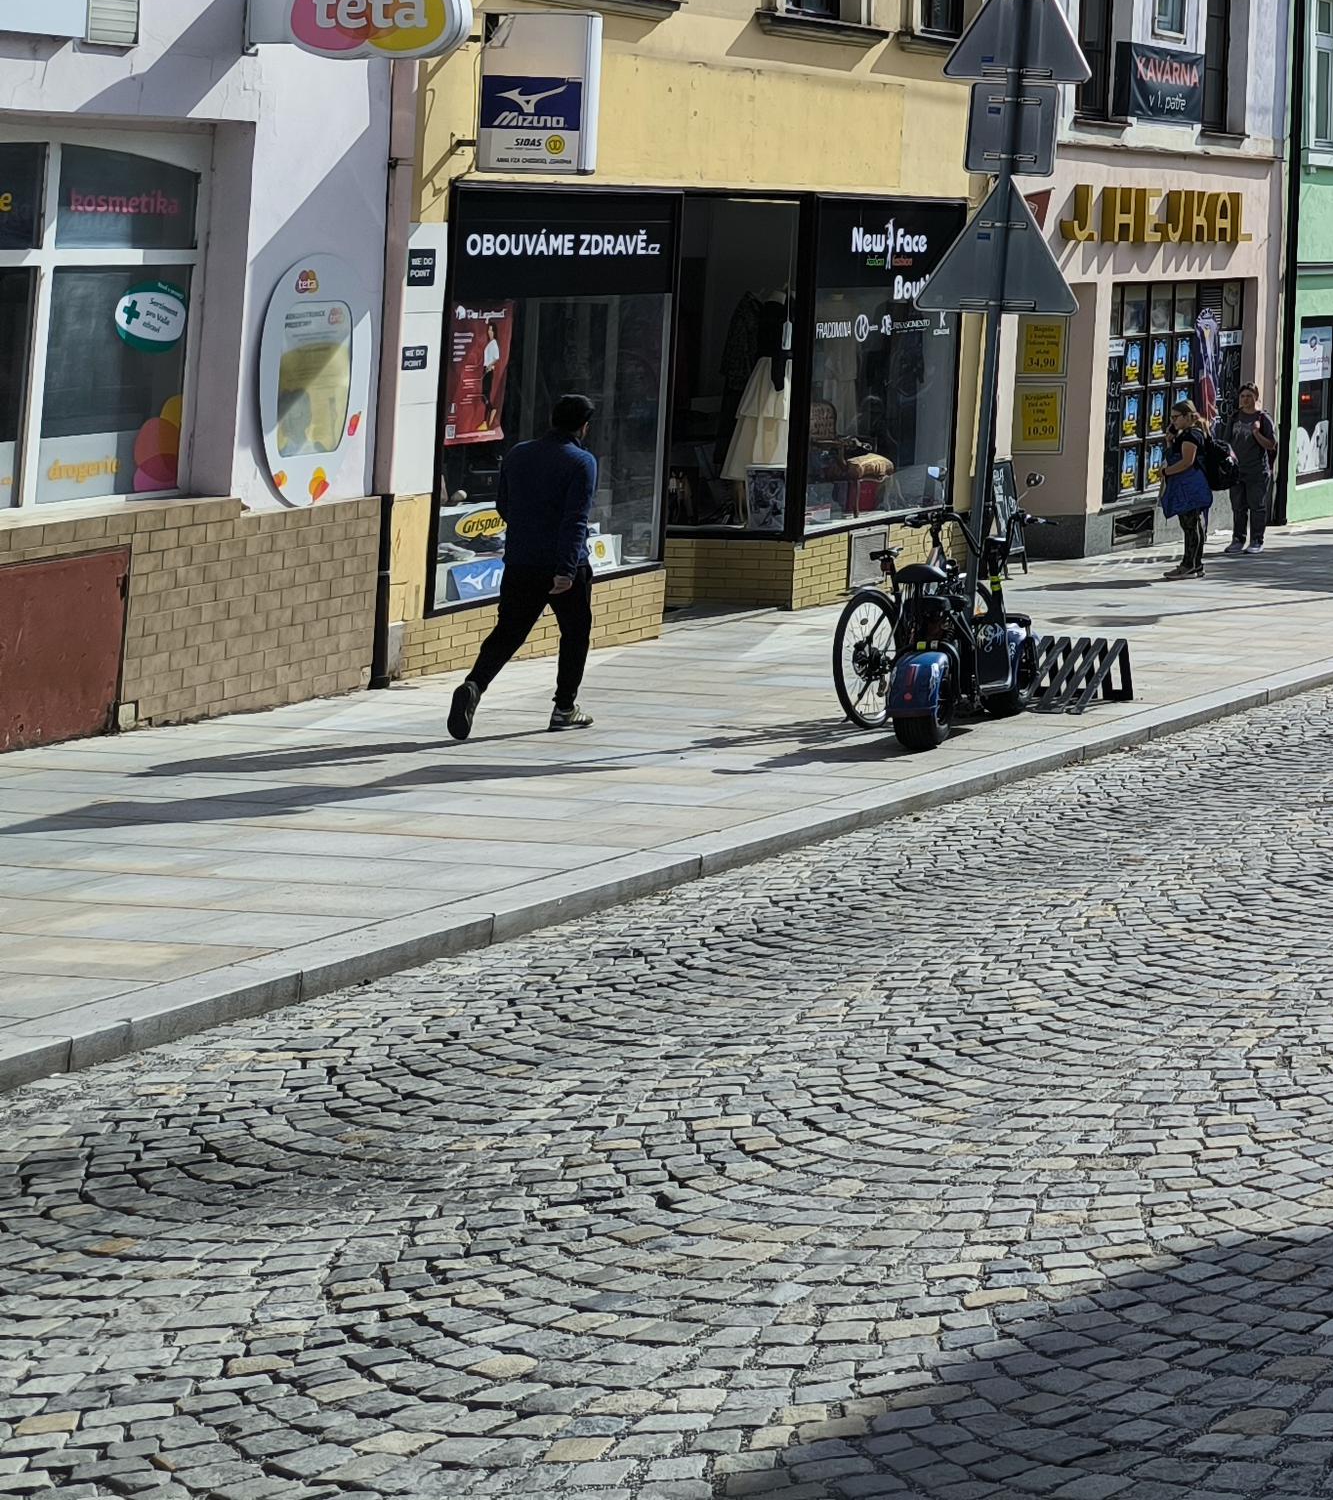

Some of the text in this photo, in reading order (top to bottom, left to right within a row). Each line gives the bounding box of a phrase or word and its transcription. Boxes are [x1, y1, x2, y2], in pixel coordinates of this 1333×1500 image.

[1136, 55, 1200, 88] KAVÁRNA
[1149, 94, 1155, 107] v
[1157, 91, 1163, 108] 1.
[492, 110, 566, 128] MIZUNO
[514, 137, 543, 147] SIDAS
[70, 189, 181, 216] kosmetika
[1104, 186, 1253, 243] HEJKAL
[466, 228, 576, 256] OBOUVÁME
[851, 226, 928, 253] New Face
[298, 278, 317, 289] teta
[48, 455, 120, 484] drogerie
